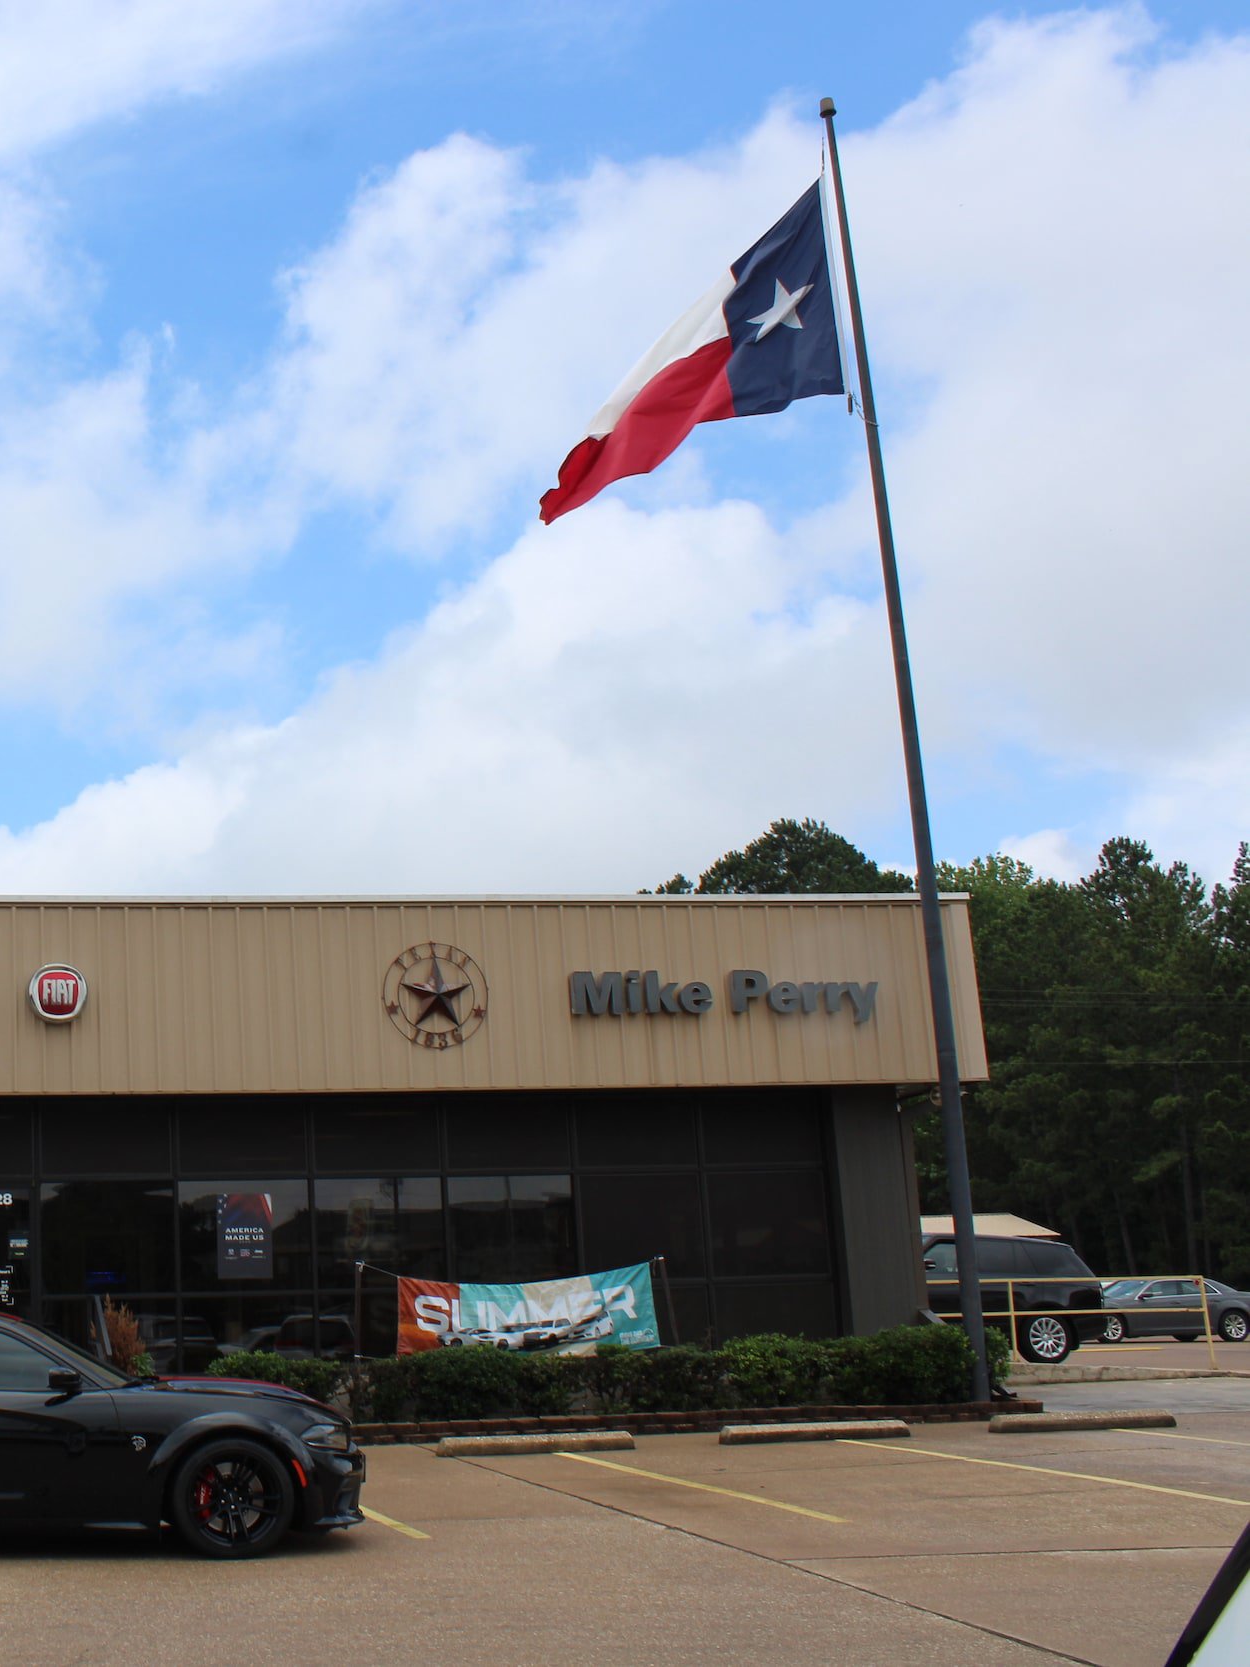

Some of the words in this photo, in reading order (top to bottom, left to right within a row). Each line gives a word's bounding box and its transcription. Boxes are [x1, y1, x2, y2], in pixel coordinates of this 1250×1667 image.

[43, 979, 76, 1005] FIAT
[569, 970, 713, 1015] Mike
[728, 969, 879, 1023] Perry
[410, 1026, 464, 1051] 1836
[414, 1284, 638, 1333] SUMMER
